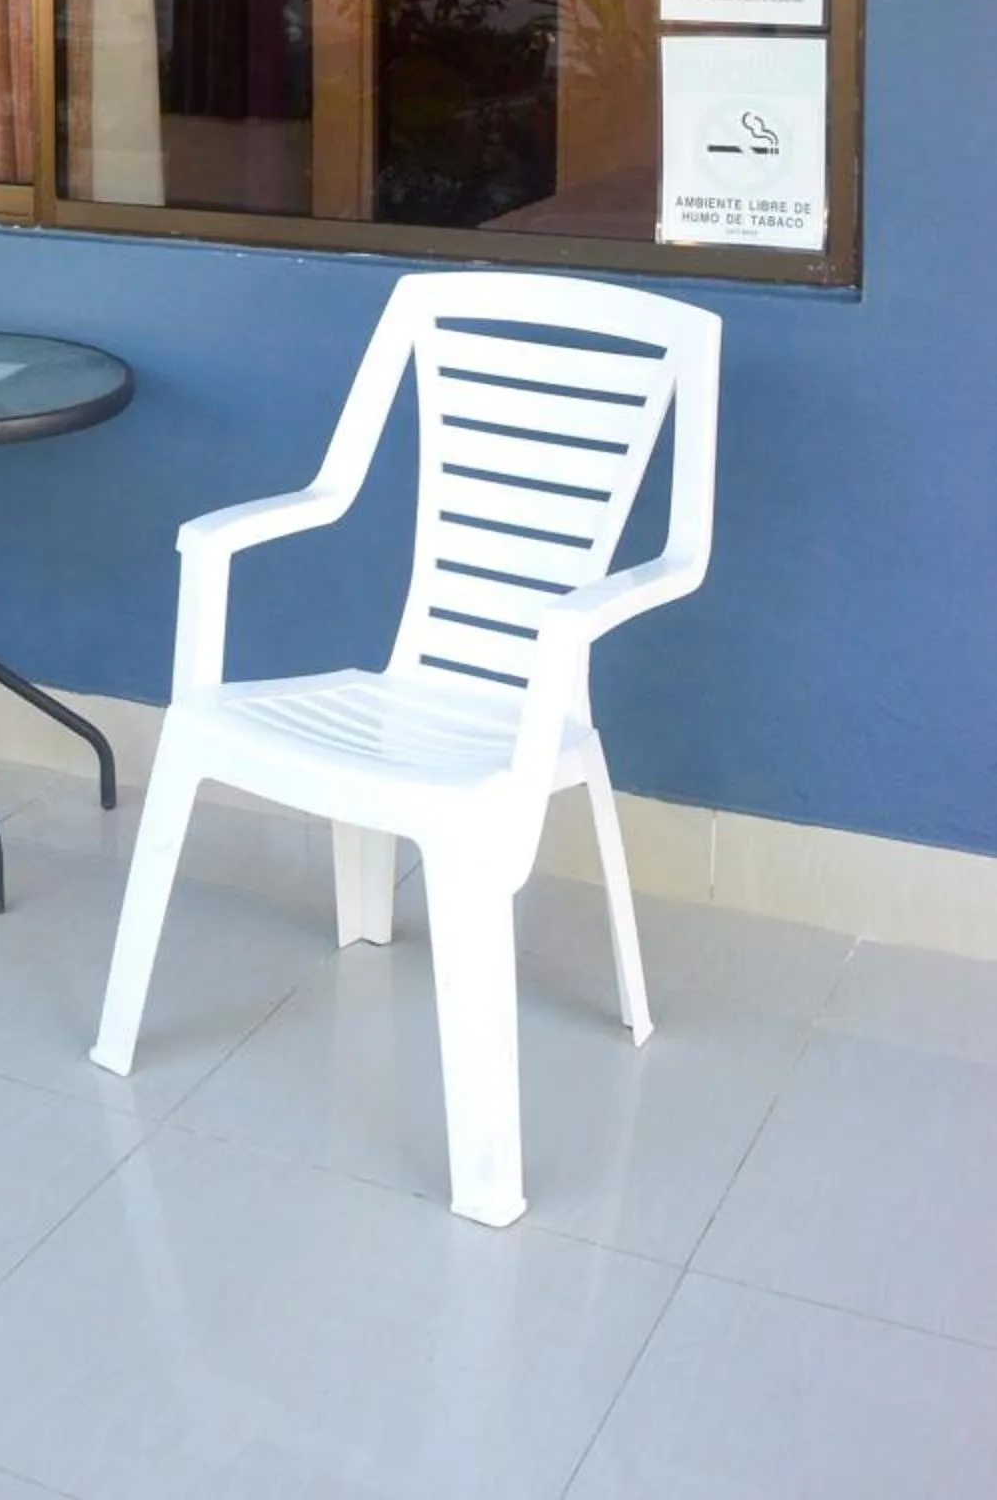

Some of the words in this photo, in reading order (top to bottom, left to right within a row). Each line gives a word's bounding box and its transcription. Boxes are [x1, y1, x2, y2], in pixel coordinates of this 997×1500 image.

[675, 195, 742, 211] AMBIENTE
[748, 199, 788, 213] LIBRE
[794, 201, 811, 215] DE
[682, 211, 719, 224] HUMO
[726, 213, 742, 225] DE
[751, 215, 804, 229] TABACO
